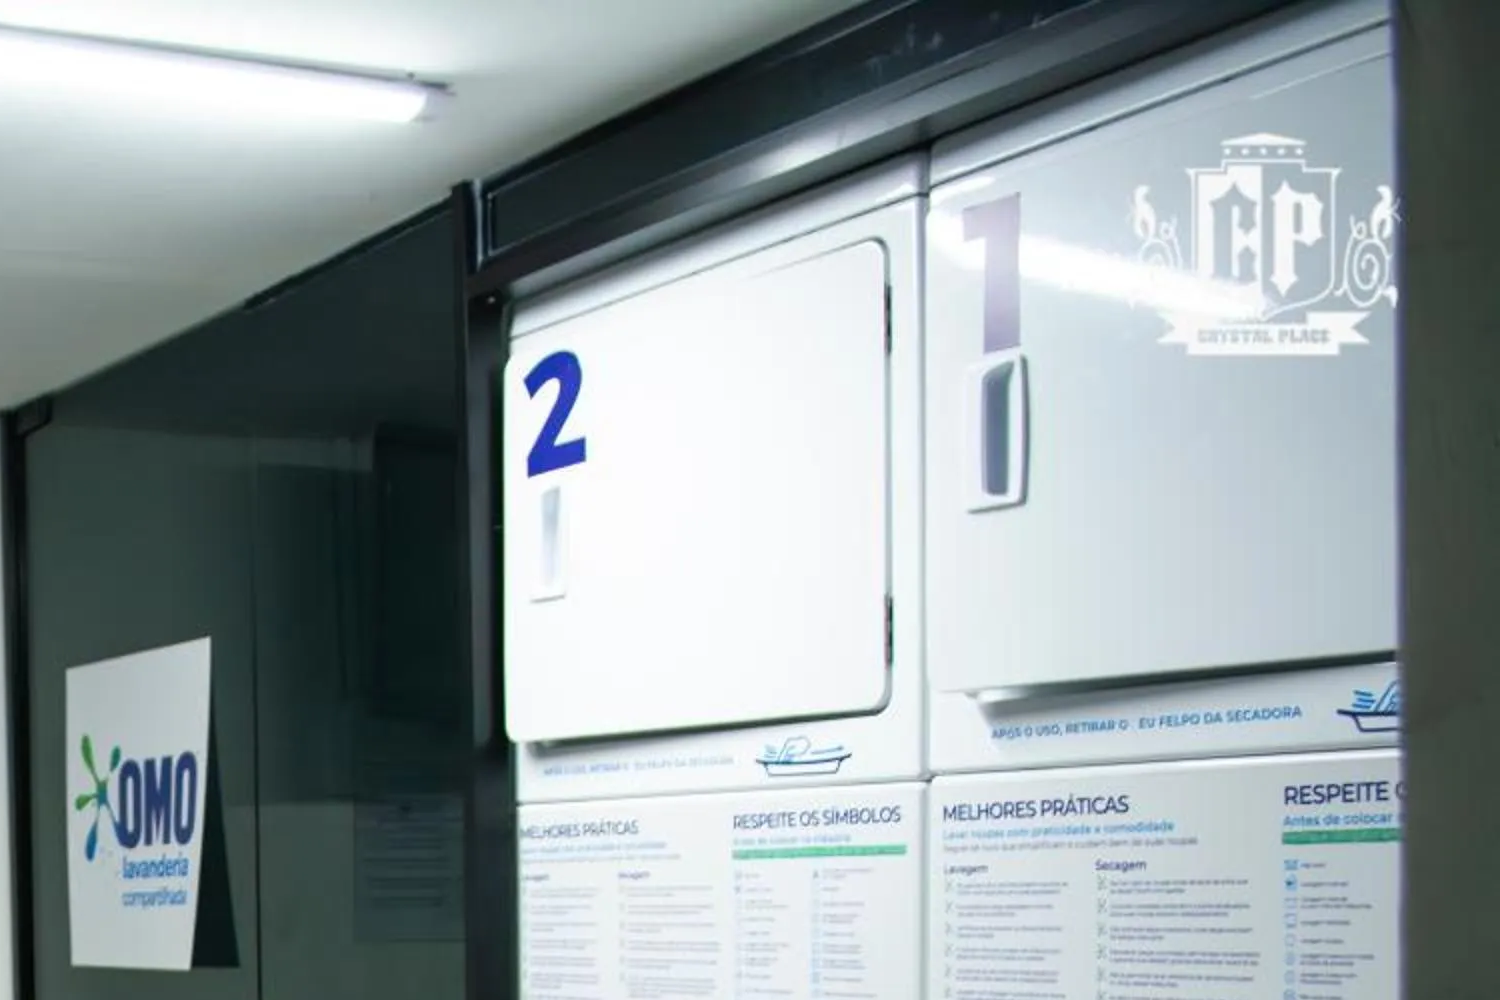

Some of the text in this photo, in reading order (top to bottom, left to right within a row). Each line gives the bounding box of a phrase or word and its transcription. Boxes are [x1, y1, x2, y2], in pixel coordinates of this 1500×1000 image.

[962, 191, 1021, 356] 1
[523, 350, 586, 479] 2
[991, 724, 1023, 740] APÓS
[1035, 725, 1063, 739] USO,
[1065, 720, 1116, 735] RETIRAR
[1138, 717, 1156, 730] EU
[1159, 713, 1201, 728] FELPO
[1203, 711, 1223, 725] DA
[1226, 705, 1304, 723] SECADORA
[116, 751, 198, 850] OMO
[1283, 781, 1390, 805] RESPEITE
[732, 804, 902, 830] RESPEITE OS SÍMBOLOS
[943, 793, 1130, 822] MELHORES PRÁTICAS
[1283, 813, 1393, 826] Antes de colocar
[519, 818, 639, 839] MELHORES PRÁTICAS
[122, 853, 189, 880] lavanderia
[943, 863, 989, 876] Lavagem
[1095, 858, 1147, 873] Secagem
